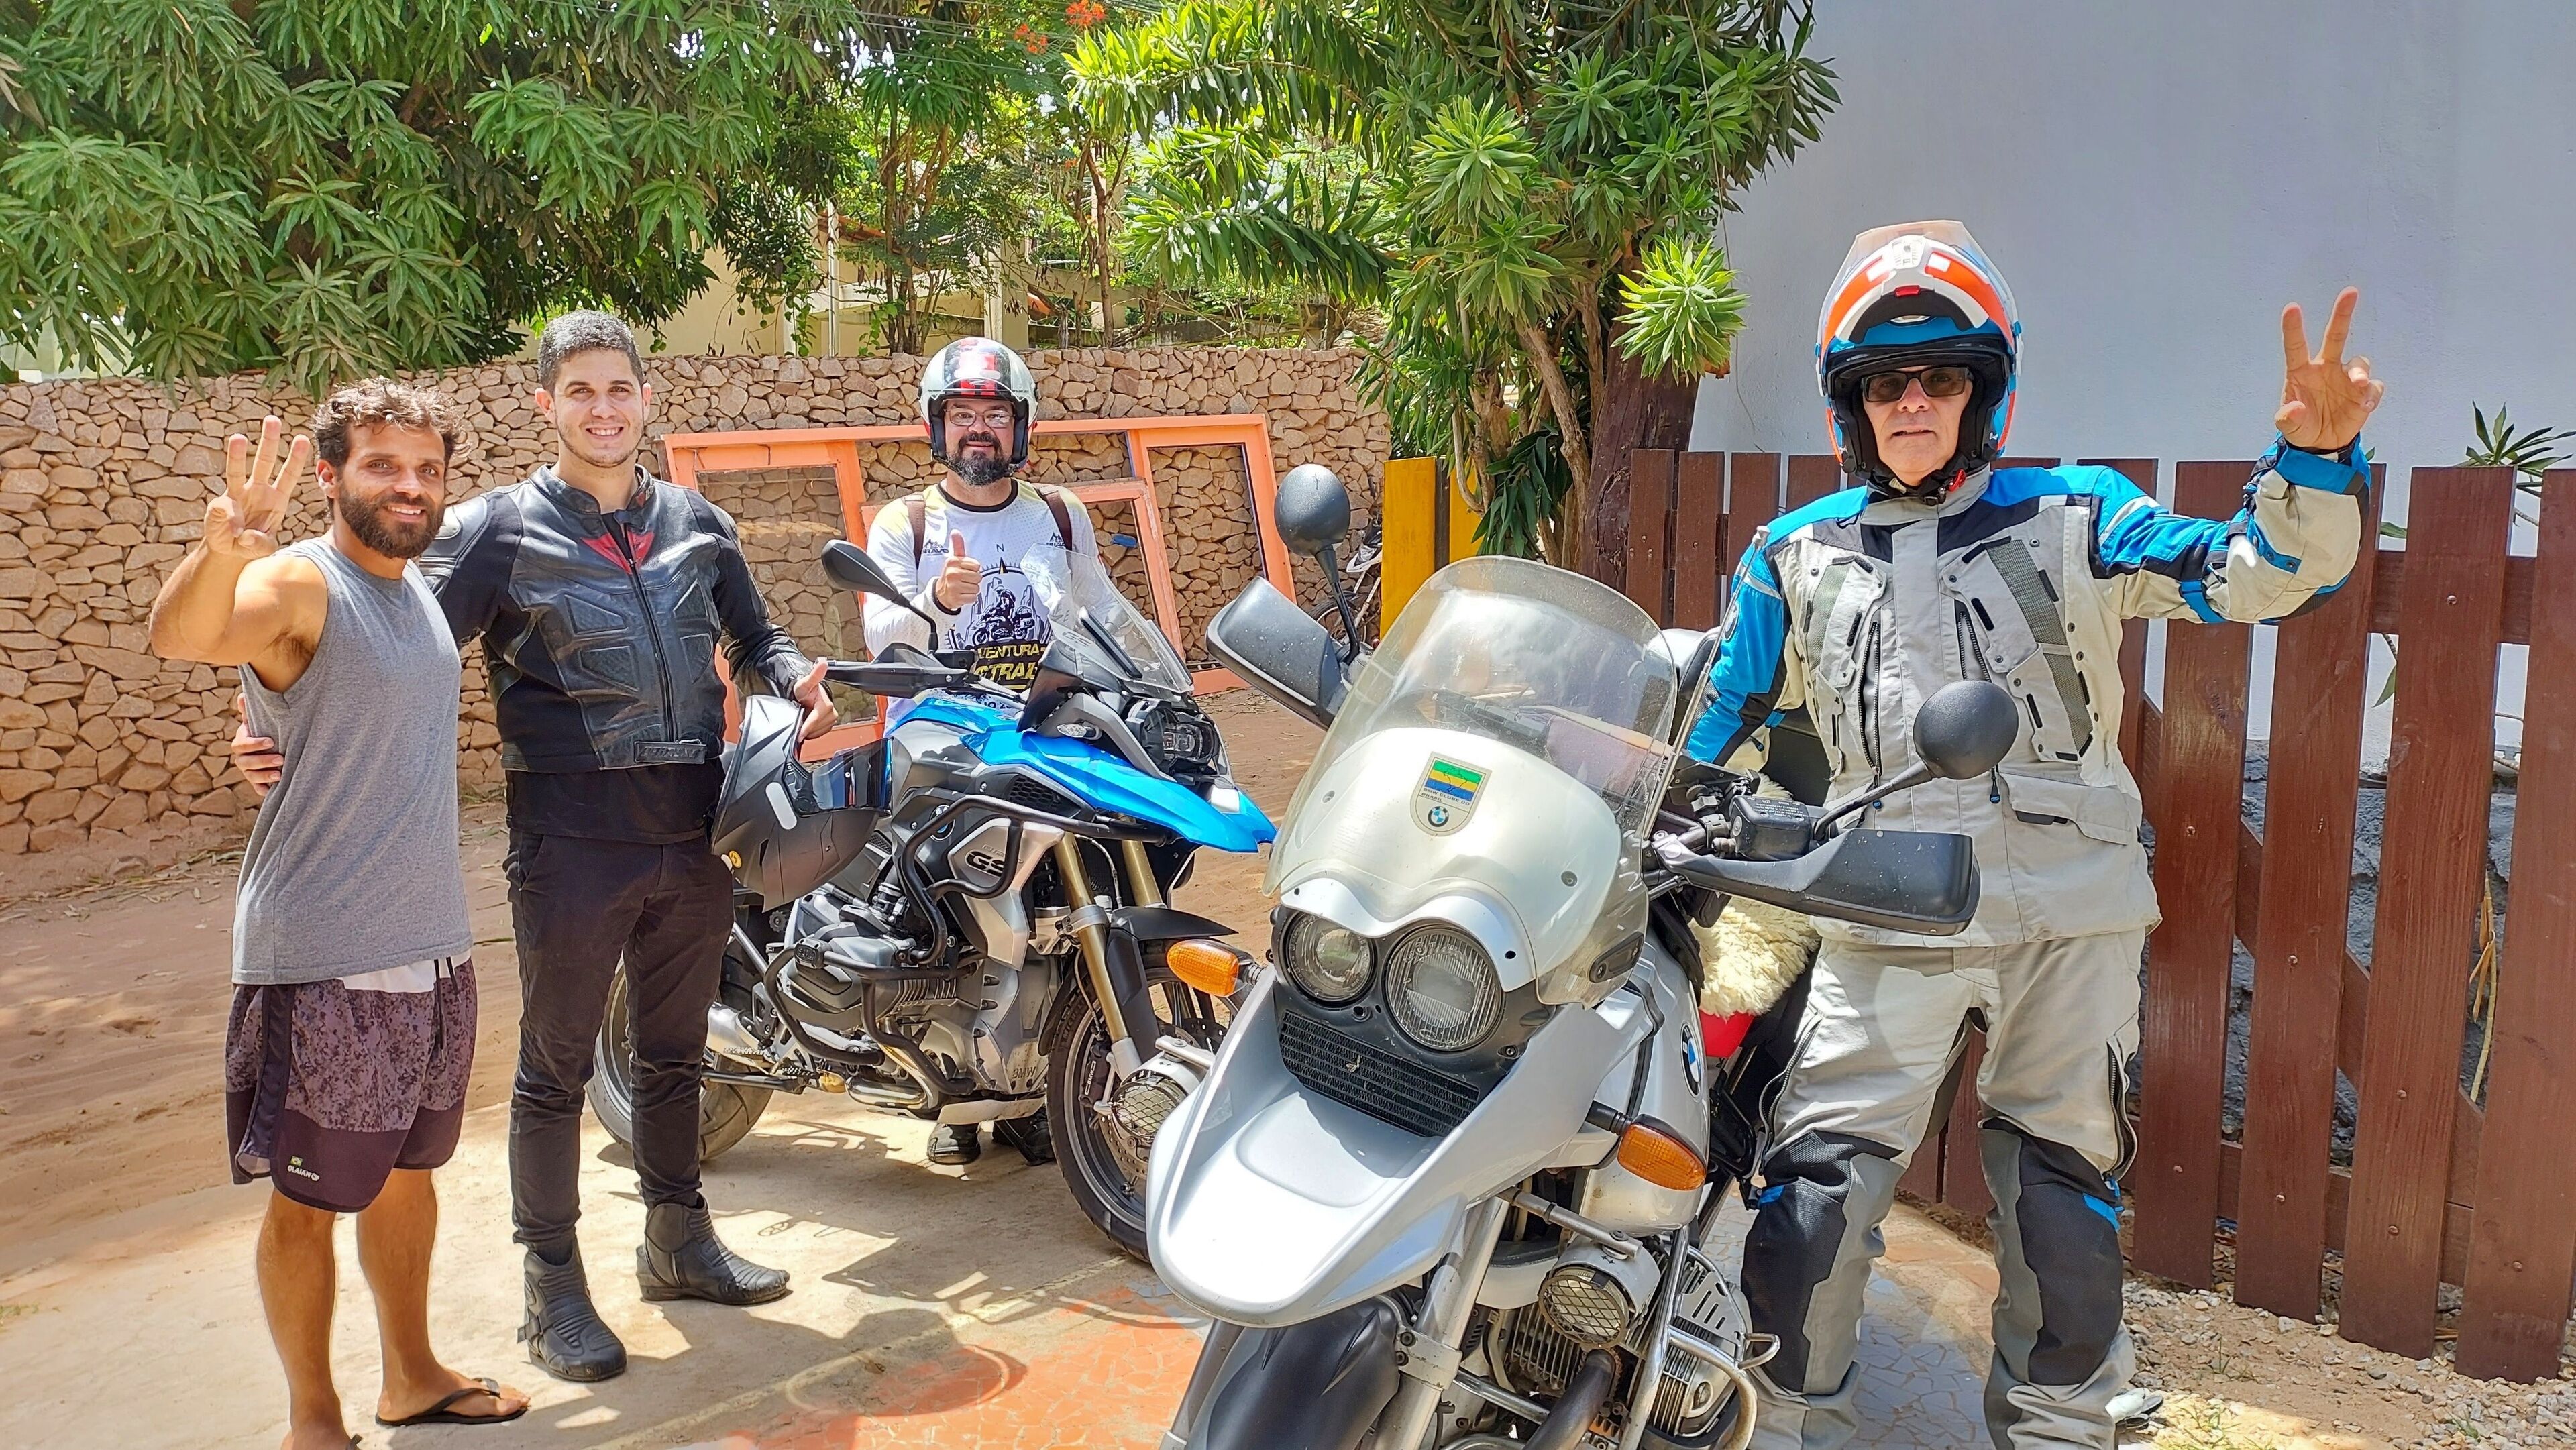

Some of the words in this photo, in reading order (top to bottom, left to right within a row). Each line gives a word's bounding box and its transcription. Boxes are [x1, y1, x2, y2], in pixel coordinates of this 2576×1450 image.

[996, 543, 1004, 553] N
[977, 643, 1040, 659] VENTURA
[1424, 787, 1438, 795] BMW
[1421, 793, 1443, 802] BRASIL
[1012, 1066, 1036, 1079] BMW
[287, 1164, 311, 1178] OLAIAN
